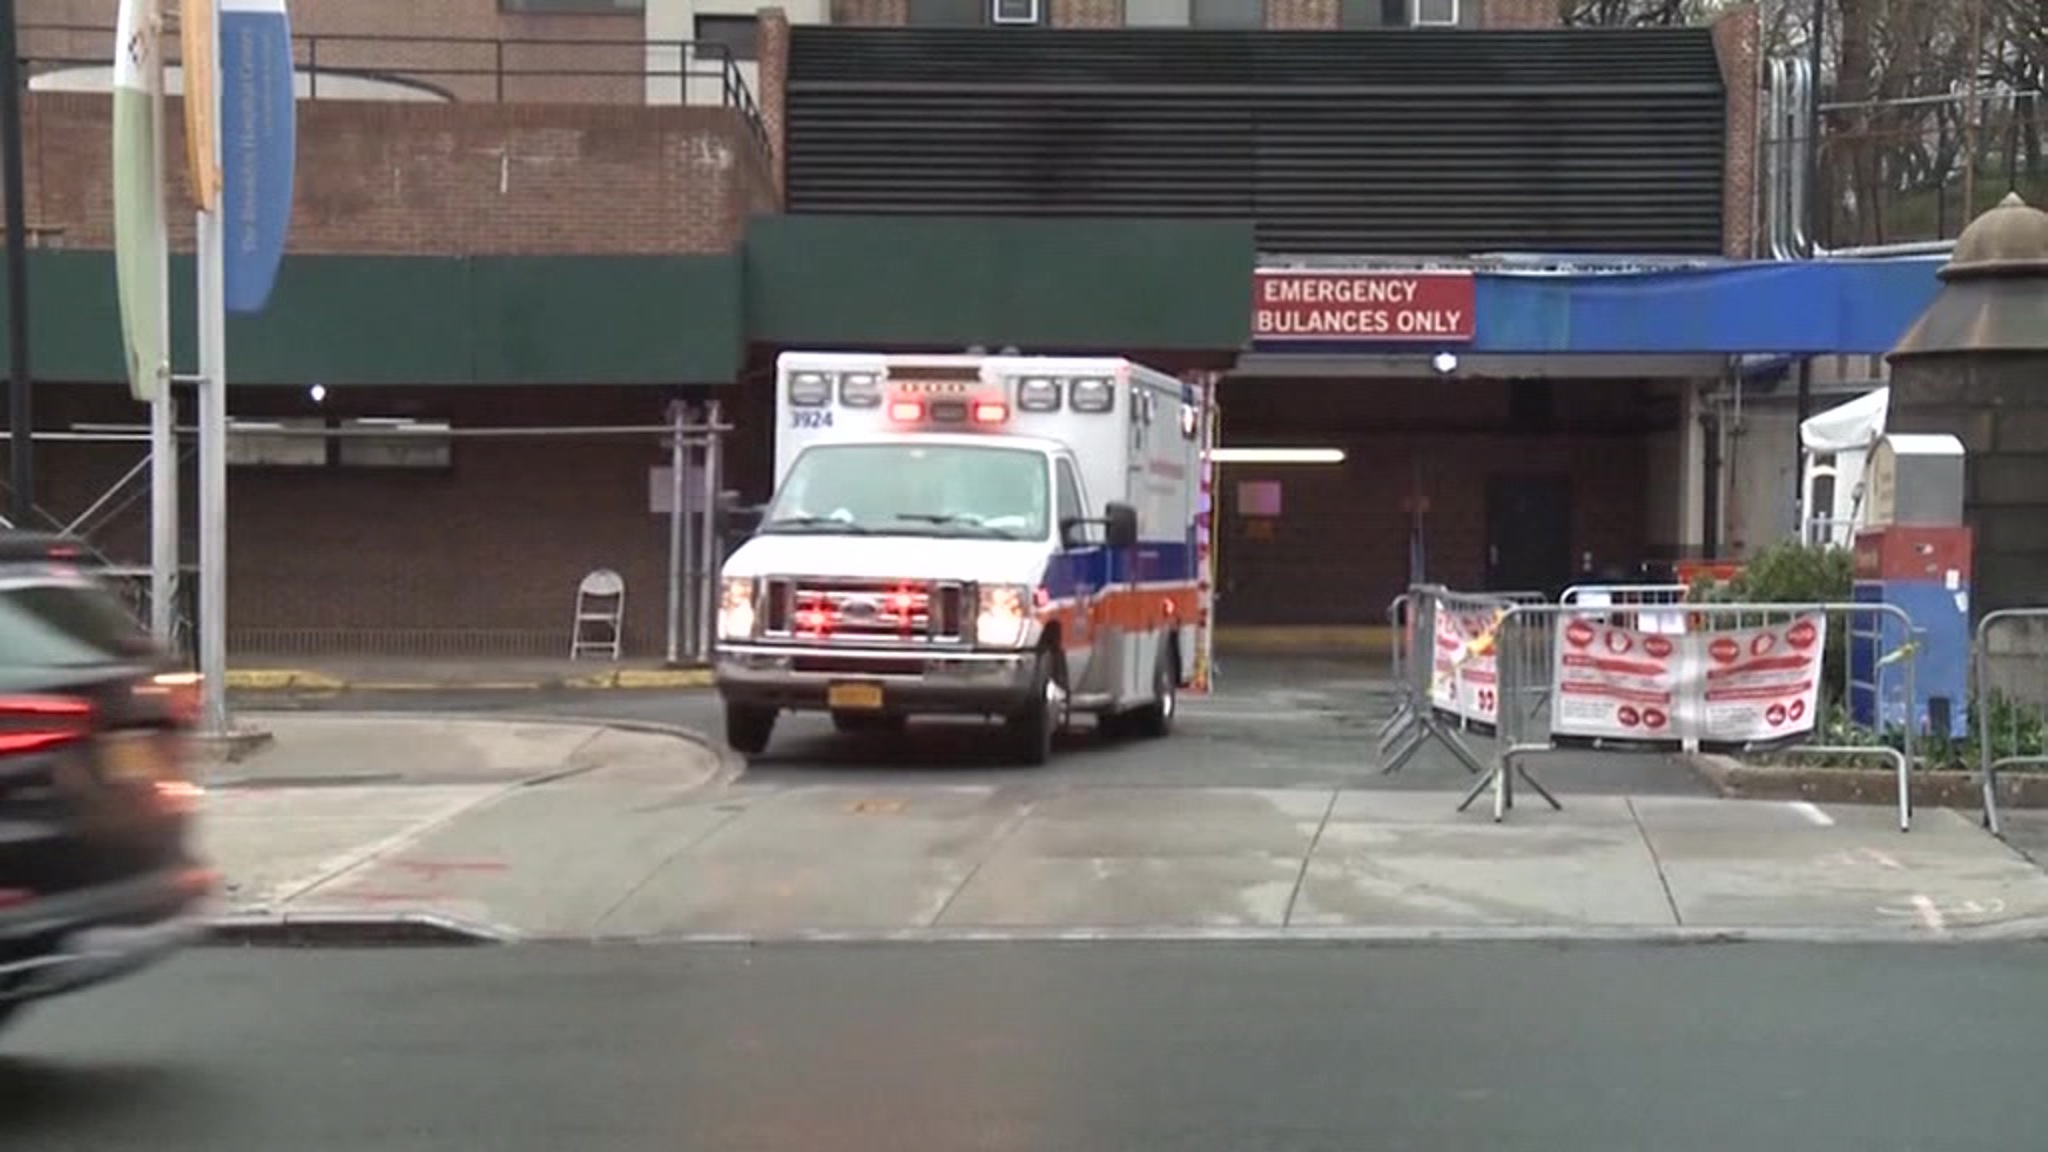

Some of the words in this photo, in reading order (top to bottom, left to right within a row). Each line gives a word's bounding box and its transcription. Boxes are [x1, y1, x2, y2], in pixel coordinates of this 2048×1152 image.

[1264, 279, 1418, 301] EMERGENCY
[1253, 310, 1389, 332] BULANCES
[1396, 310, 1461, 332] ONLY
[790, 409, 833, 429] 3924
